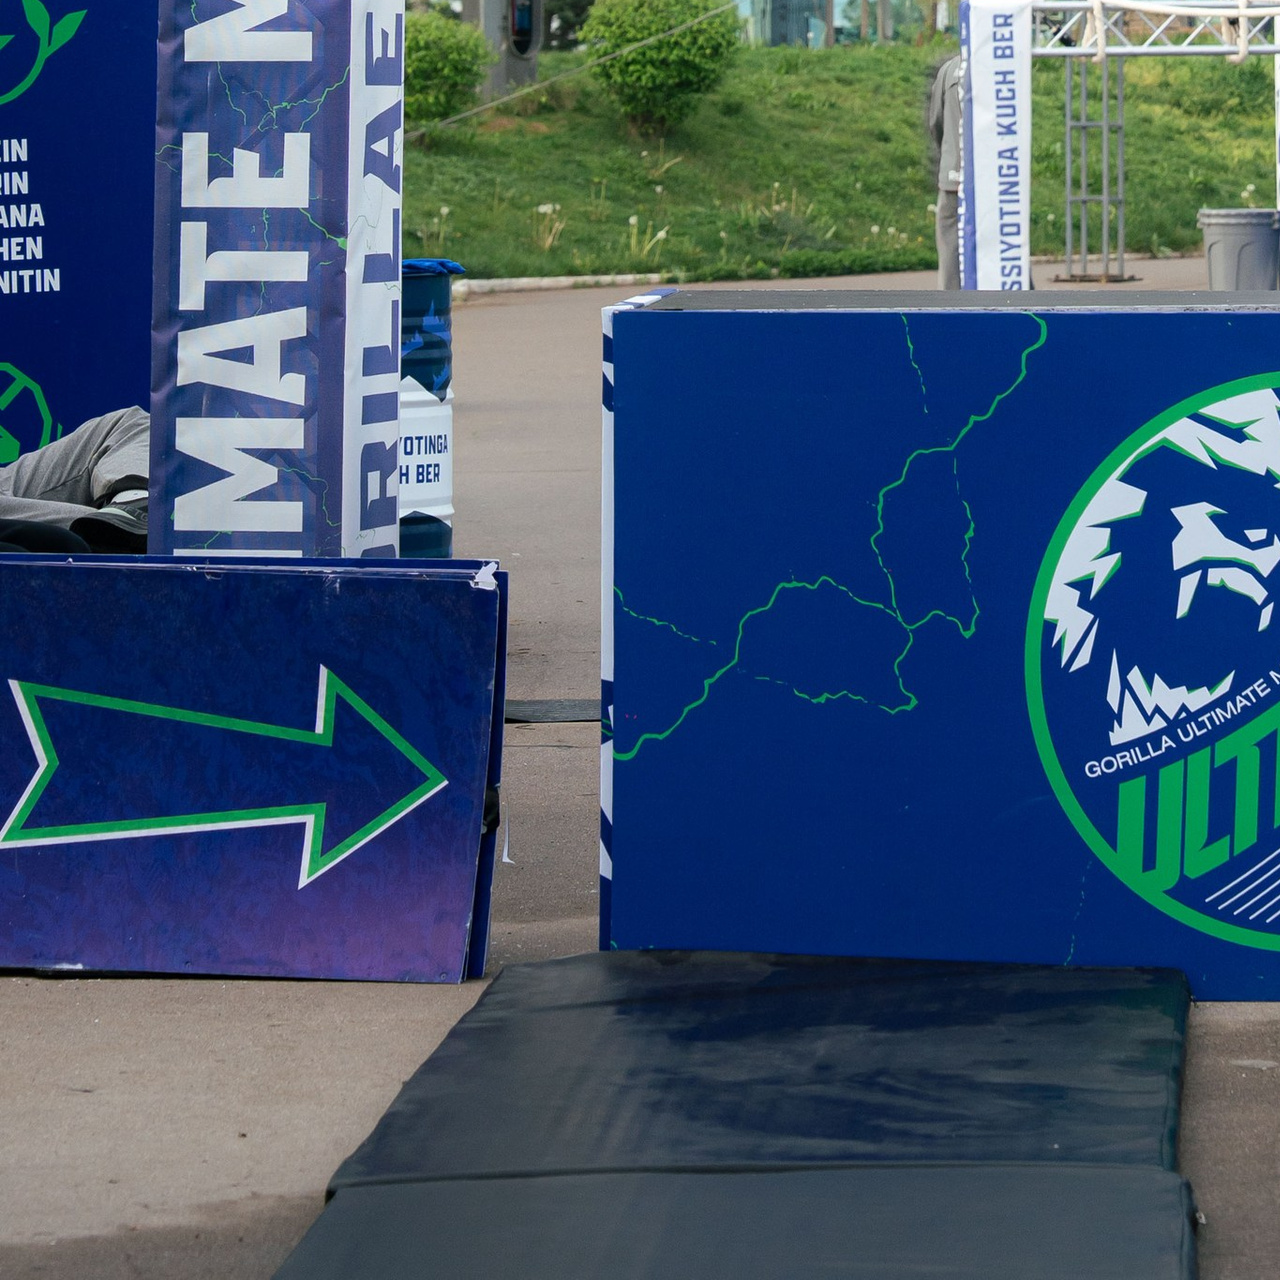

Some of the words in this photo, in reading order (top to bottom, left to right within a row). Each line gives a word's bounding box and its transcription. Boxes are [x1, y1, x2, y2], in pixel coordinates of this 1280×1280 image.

[993, 13, 1015, 60] BER
[995, 69, 1017, 137] KUCH
[0, 139, 28, 162] IN
[0, 171, 29, 195] IN
[172, 132, 315, 556] MATE
[399, 434, 448, 456] OTINGA
[416, 463, 440, 484] BER
[1084, 733, 1176, 778] GORILLA
[1177, 677, 1272, 744] ULTIMATE
